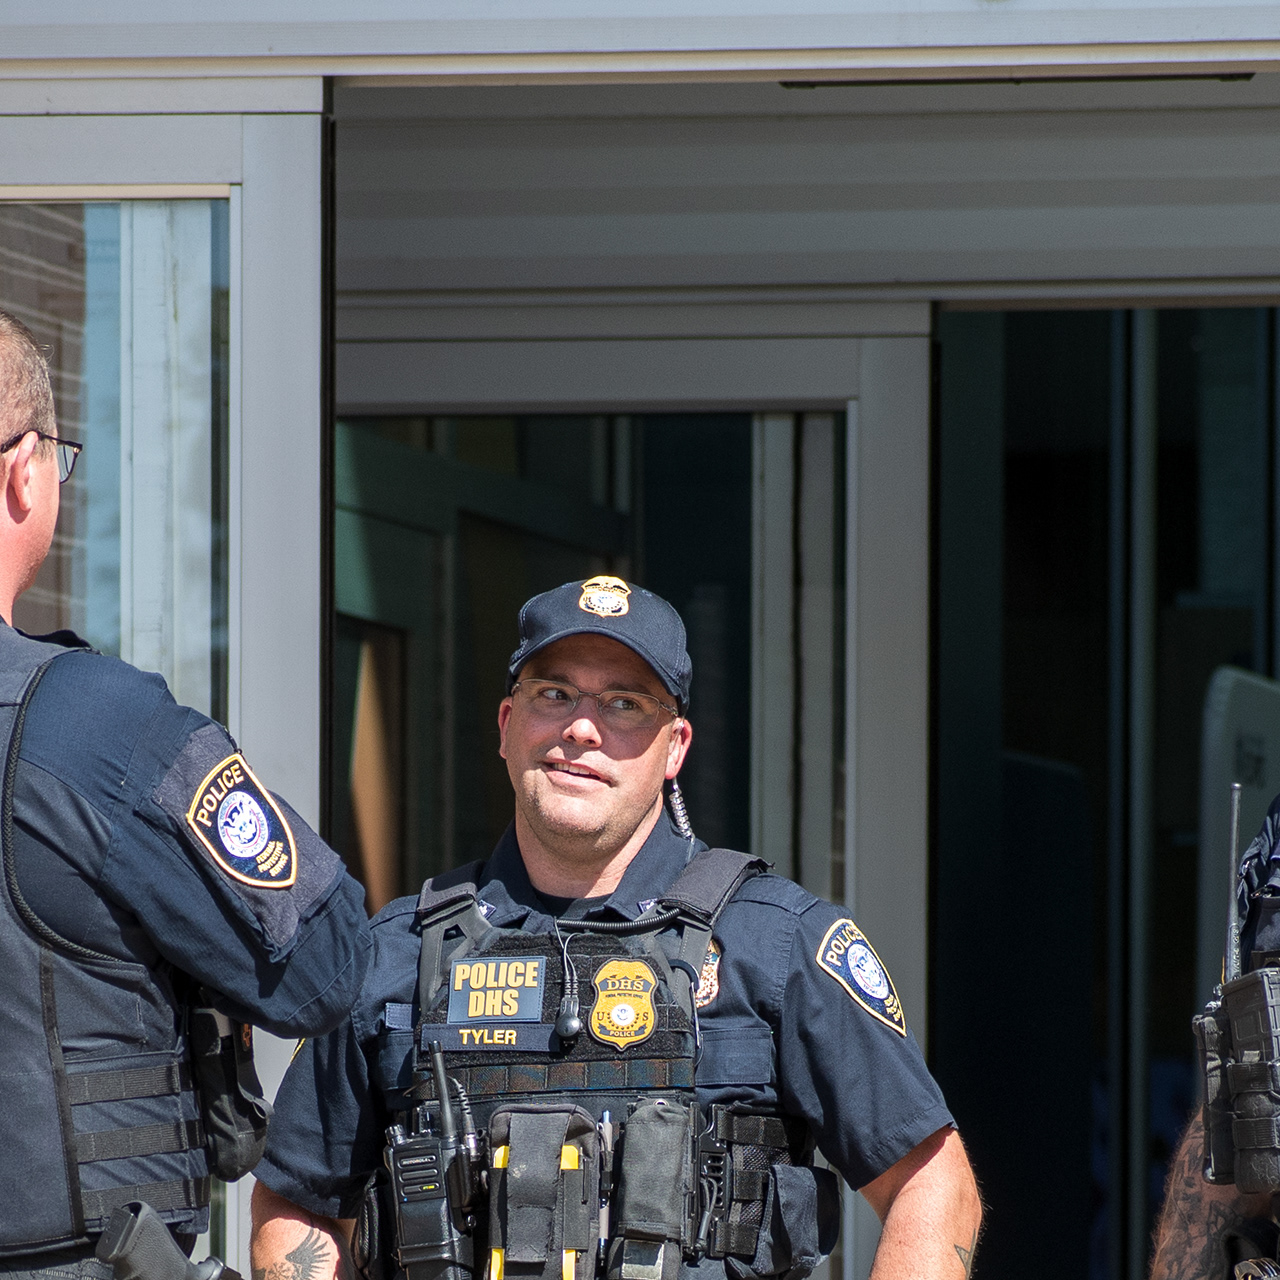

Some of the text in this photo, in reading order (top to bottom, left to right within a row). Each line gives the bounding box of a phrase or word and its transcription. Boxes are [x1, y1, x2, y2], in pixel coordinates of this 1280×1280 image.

[196, 763, 245, 828] POLICE
[454, 961, 540, 991] POLICE
[606, 979, 644, 991] DHS
[467, 989, 519, 1018] DHS
[596, 1011, 649, 1021] U S
[458, 1028, 518, 1046] TYLER
